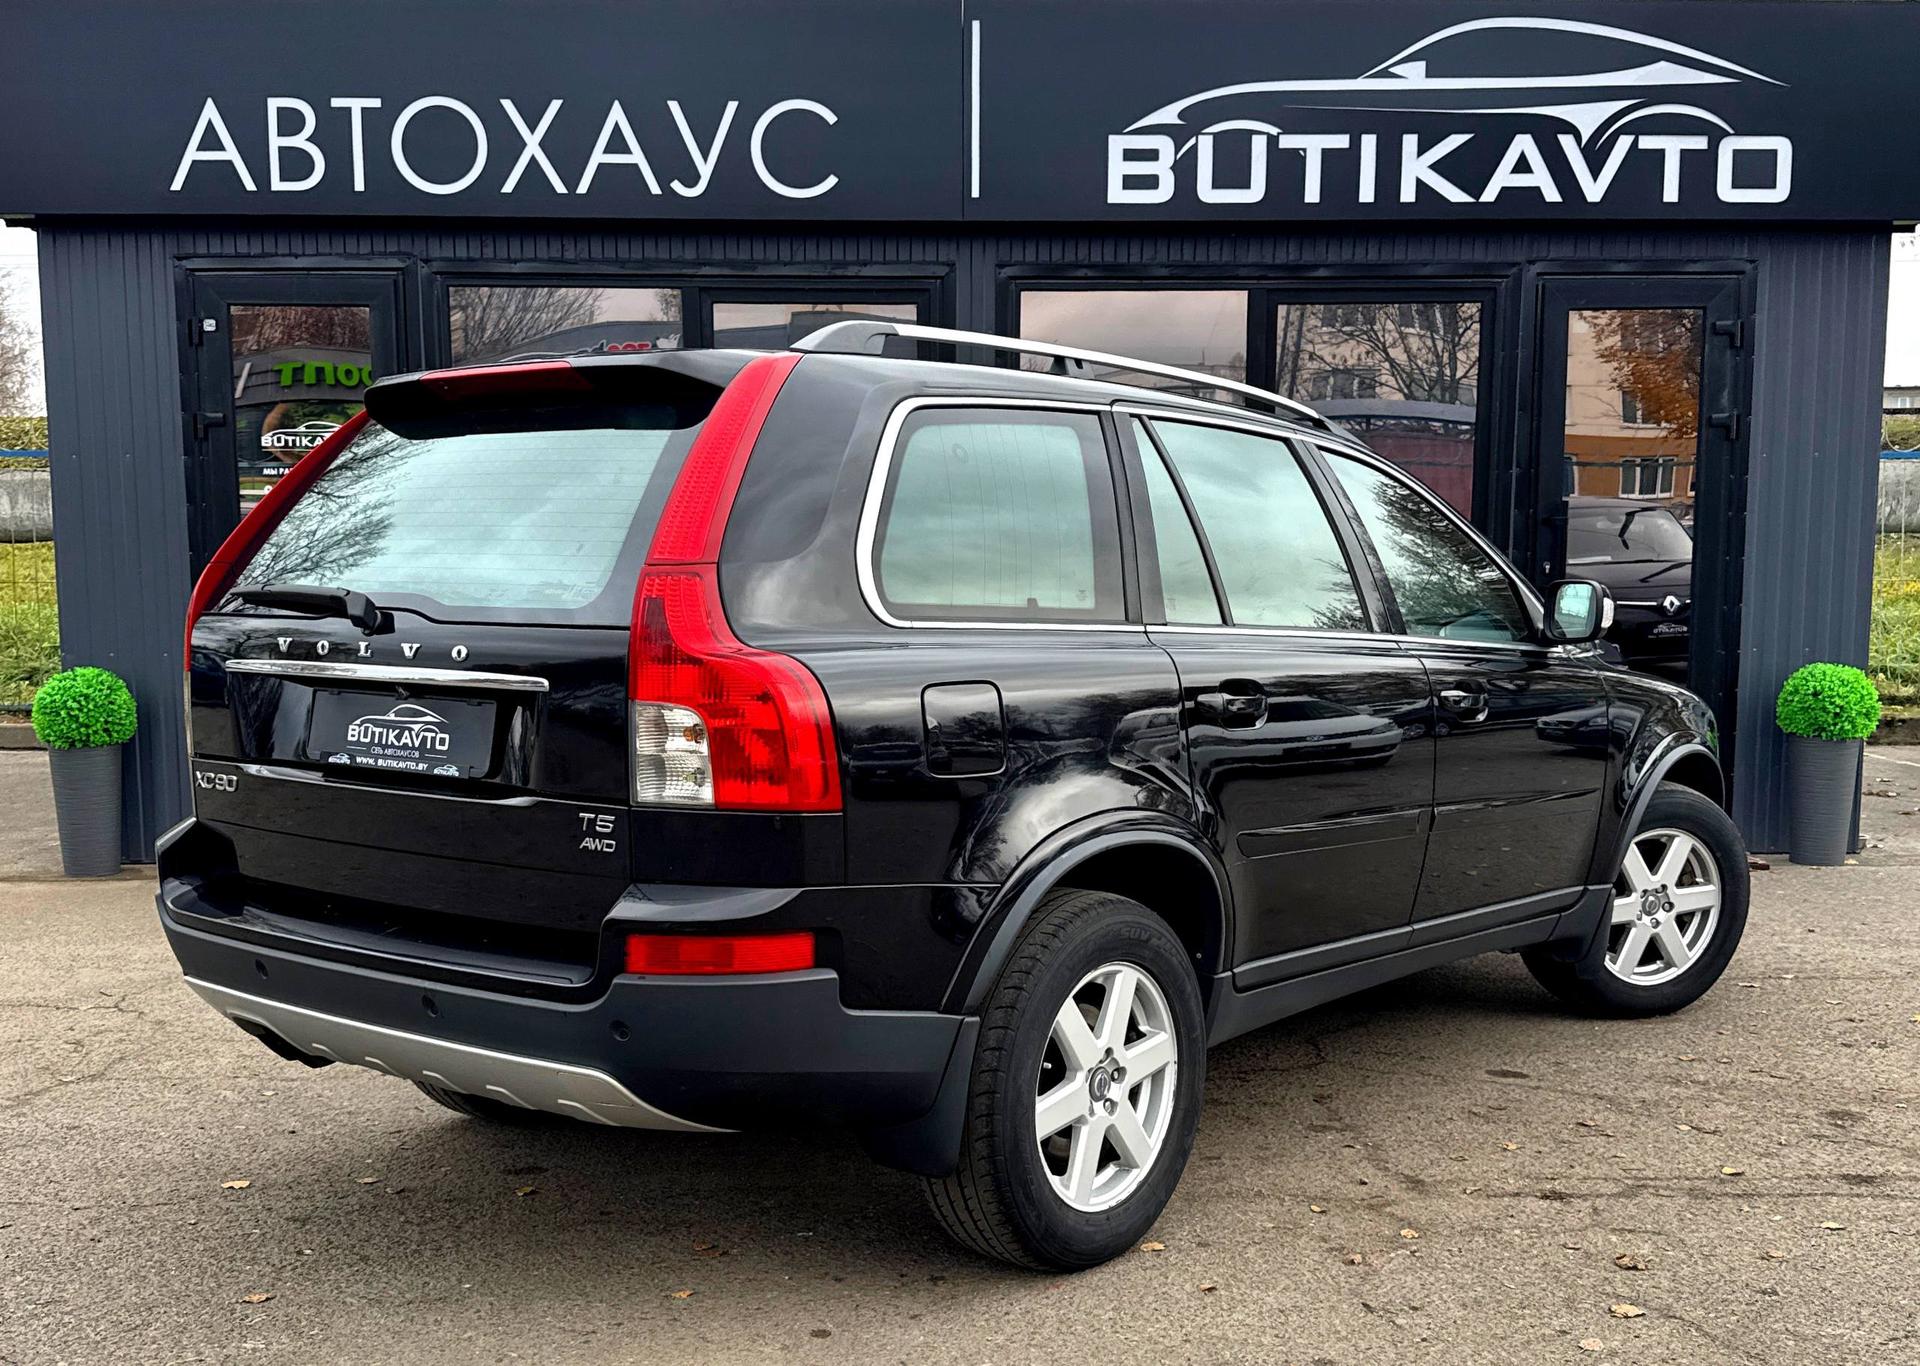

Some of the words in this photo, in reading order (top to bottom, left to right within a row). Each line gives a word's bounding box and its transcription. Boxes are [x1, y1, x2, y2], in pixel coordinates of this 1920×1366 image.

[170, 96, 839, 199] АВТОХАУС
[1107, 133, 1793, 204] BUTIKAVTO
[277, 637, 468, 662] VOLVO
[347, 725, 449, 750] BUTIKAVTO
[195, 770, 238, 792] XC90
[578, 812, 616, 833] T5
[579, 837, 616, 852] AWD
